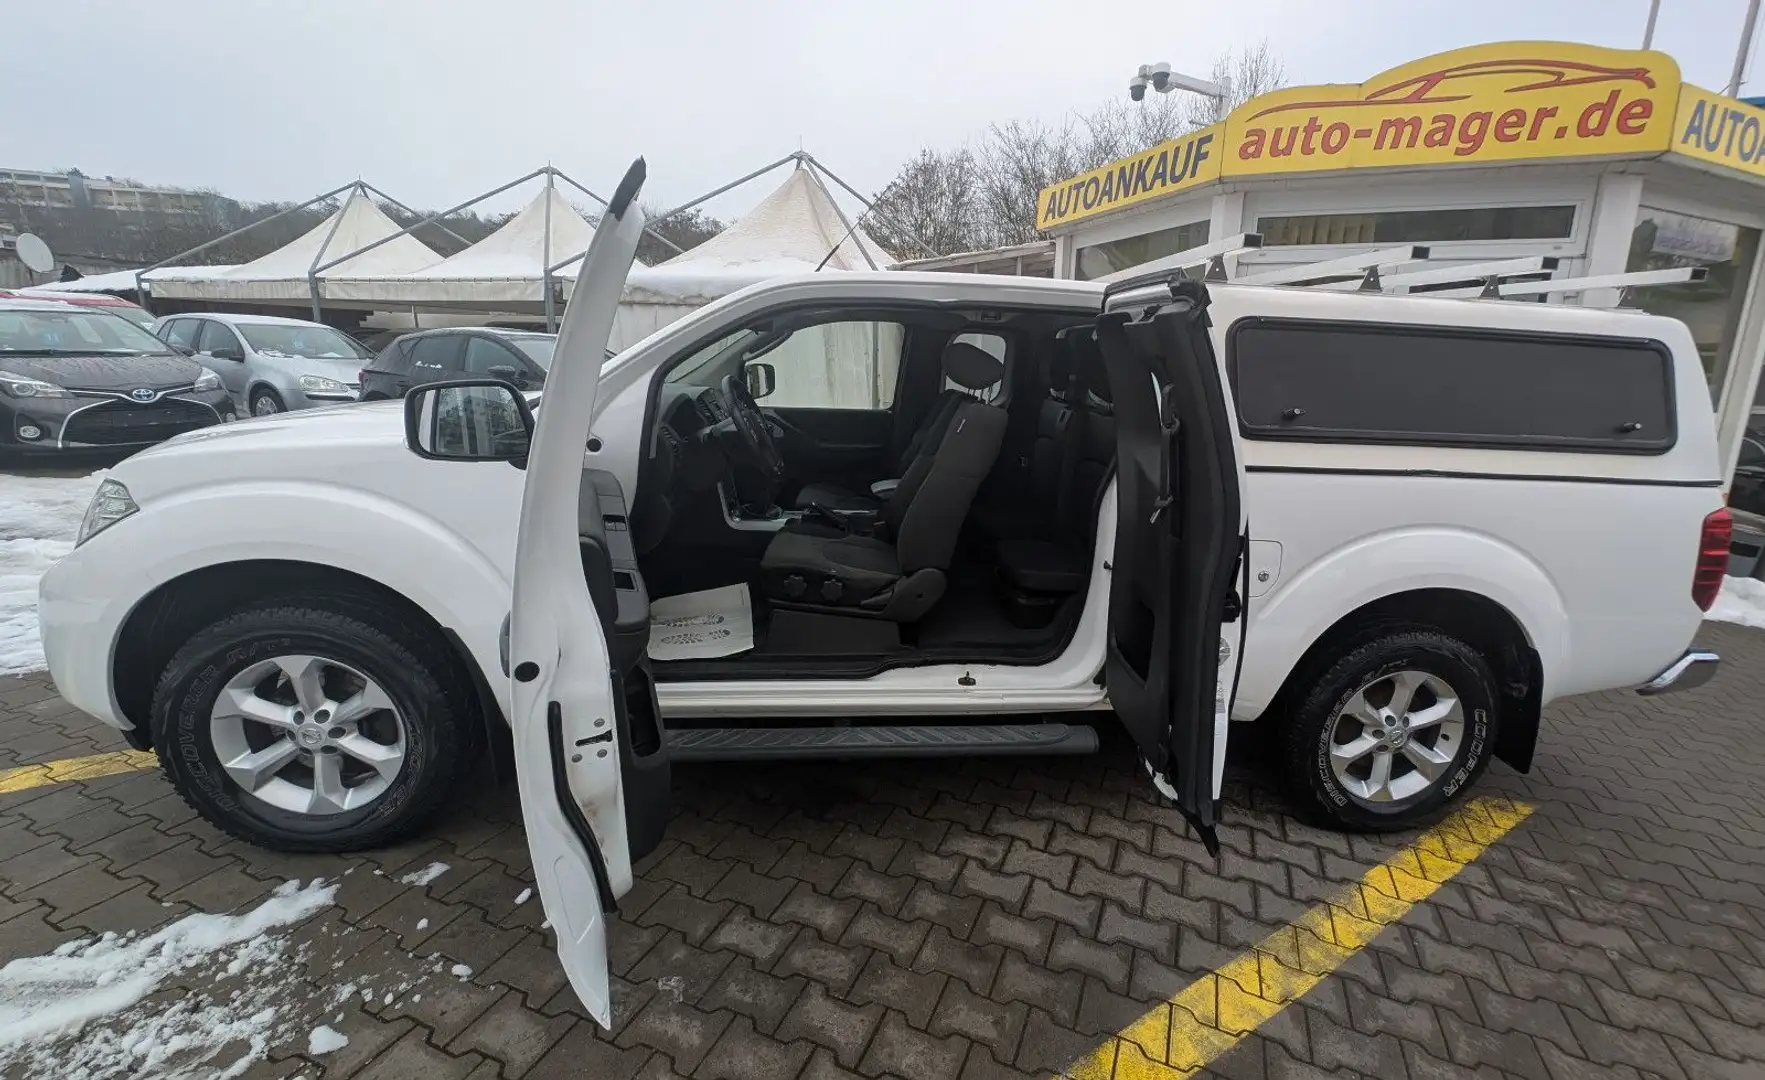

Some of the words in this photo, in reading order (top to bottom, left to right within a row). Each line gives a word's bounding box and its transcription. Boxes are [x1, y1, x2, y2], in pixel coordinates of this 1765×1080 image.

[1238, 89, 1655, 160] auto-mager.de
[1043, 134, 1214, 223] AUTOANKAUF
[1442, 708, 1488, 798] COOPER
